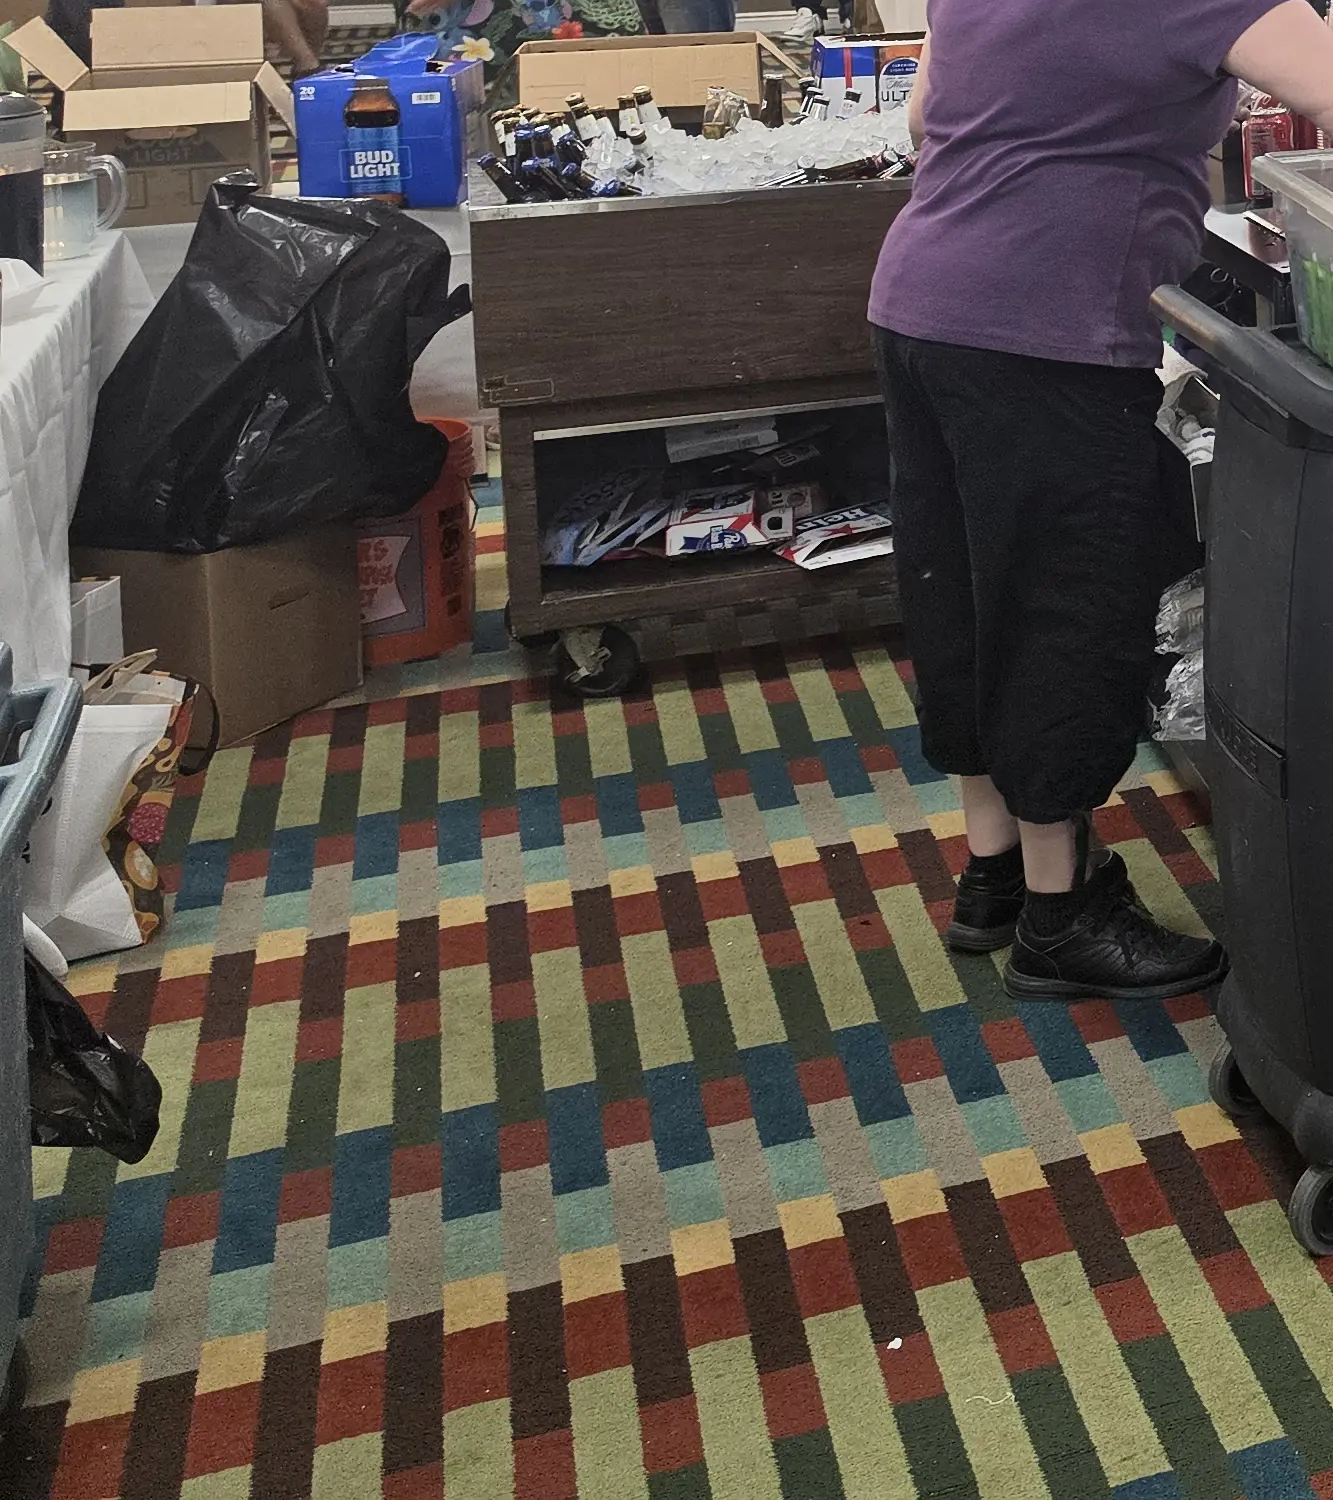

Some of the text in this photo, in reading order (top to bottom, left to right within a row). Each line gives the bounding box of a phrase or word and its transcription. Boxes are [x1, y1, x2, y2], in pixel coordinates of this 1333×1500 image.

[881, 89, 912, 102] ULT
[354, 150, 395, 164] BUD
[350, 163, 400, 178] LIGHT
